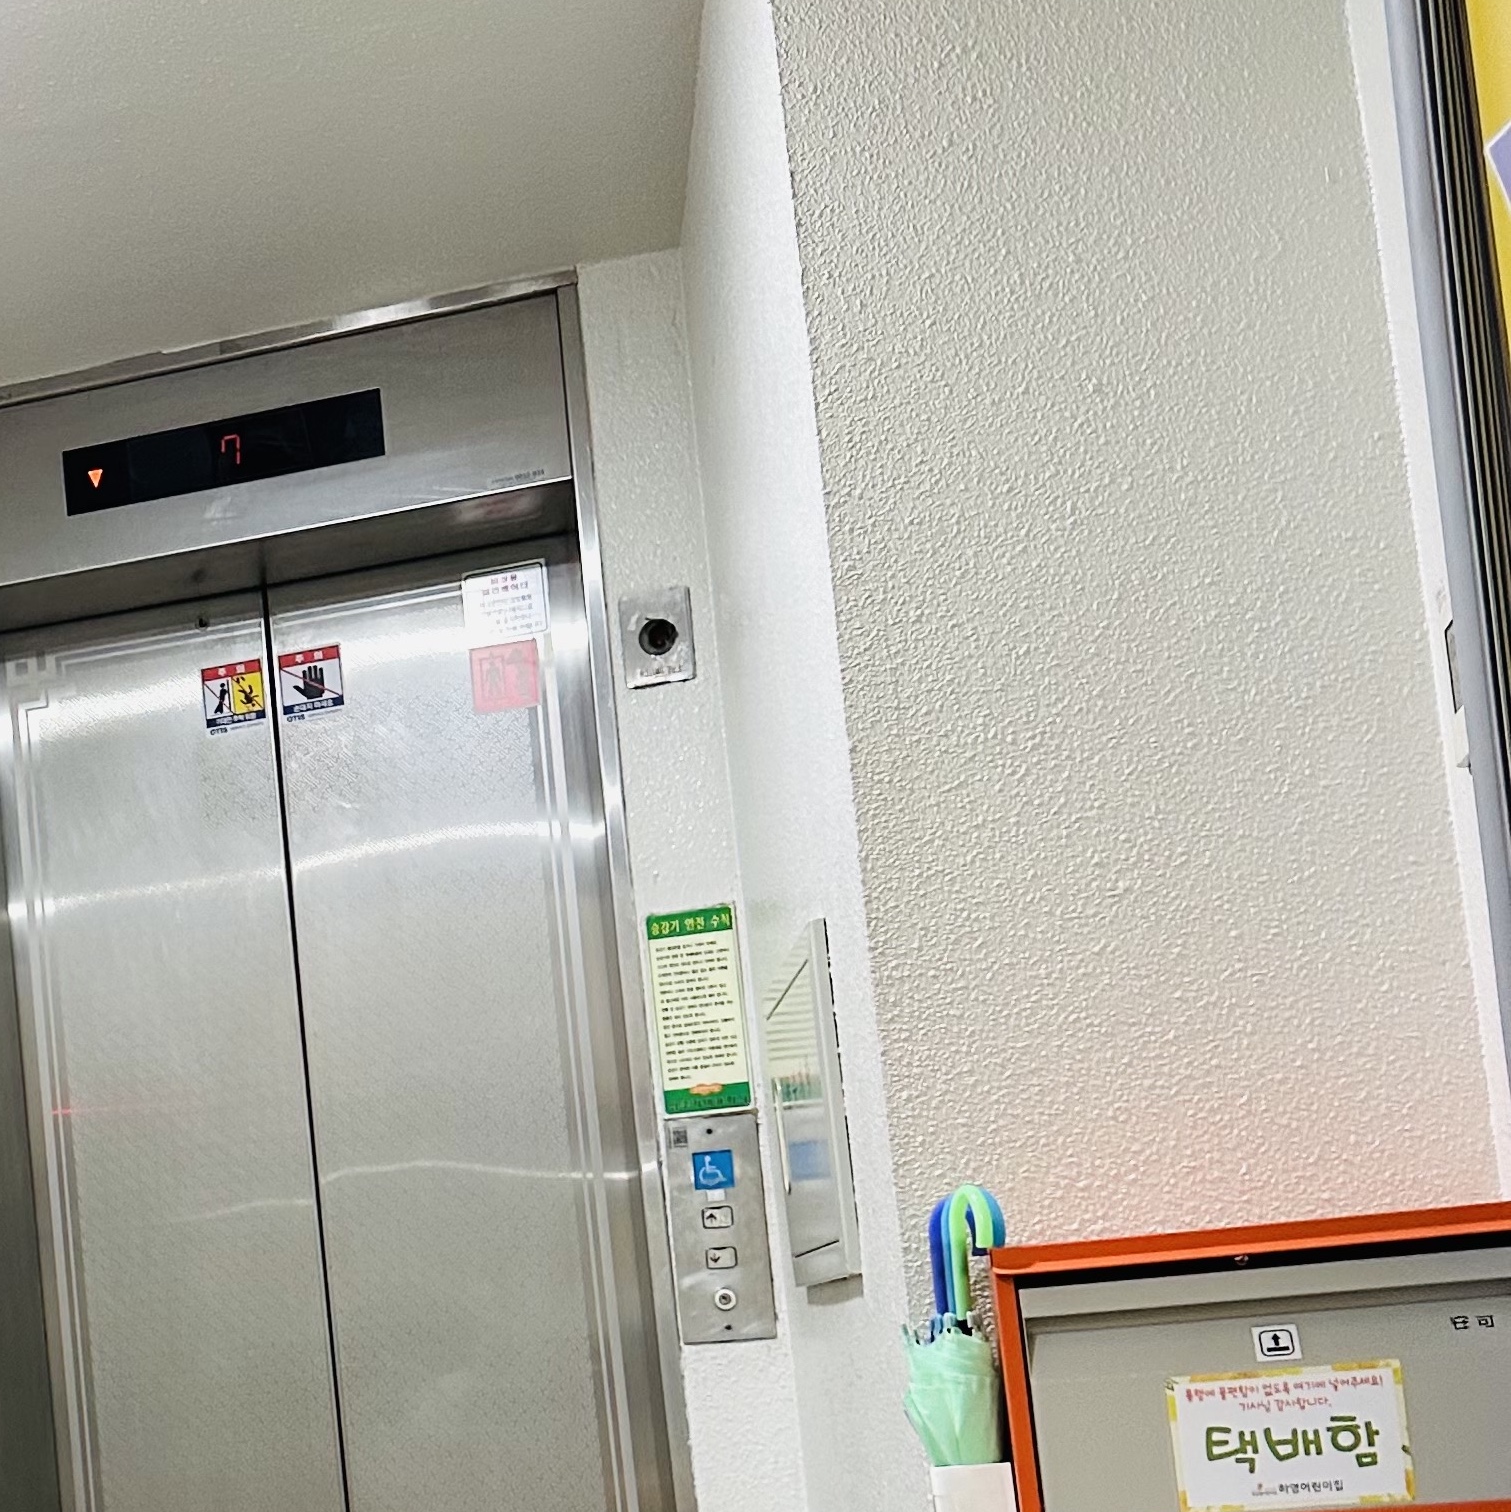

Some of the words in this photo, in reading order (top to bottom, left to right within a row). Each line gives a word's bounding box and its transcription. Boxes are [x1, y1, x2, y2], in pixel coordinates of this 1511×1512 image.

[221, 434, 241, 466] 7
[650, 918, 680, 936] 승강기
[1205, 1415, 1380, 1474] 택배함
